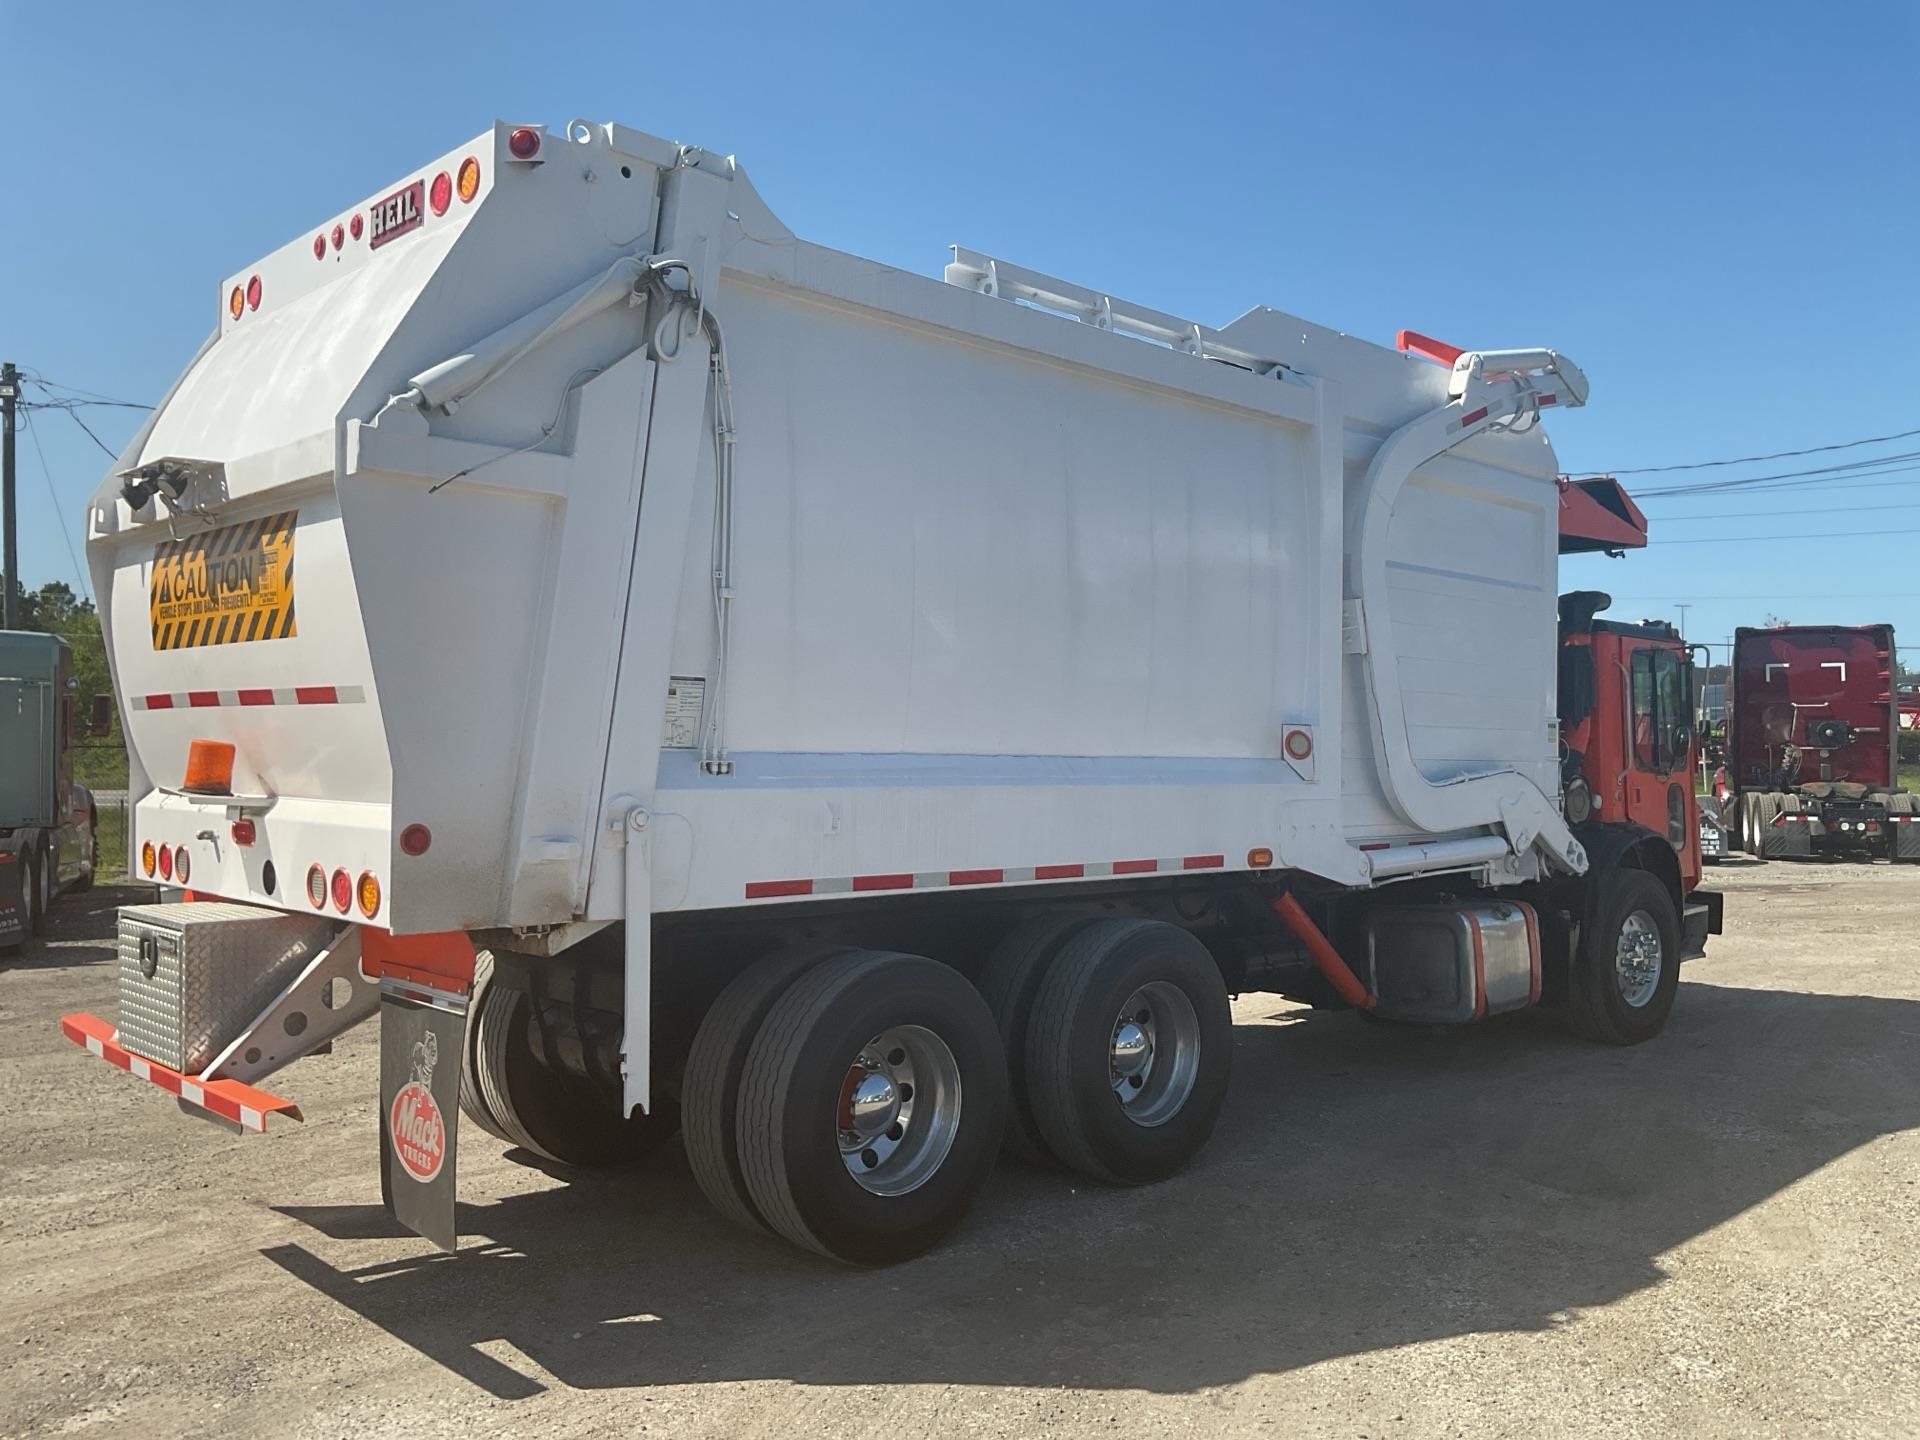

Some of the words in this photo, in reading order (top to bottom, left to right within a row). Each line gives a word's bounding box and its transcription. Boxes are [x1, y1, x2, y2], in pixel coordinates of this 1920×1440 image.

[371, 190, 417, 238] HEIL
[174, 556, 252, 602] CAUTION
[178, 602, 192, 617] STOPS
[194, 600, 203, 614] AND
[221, 593, 252, 611] FREQUENTLY
[396, 1095, 441, 1156] Mack
[403, 1143, 432, 1170] TRUCKS
